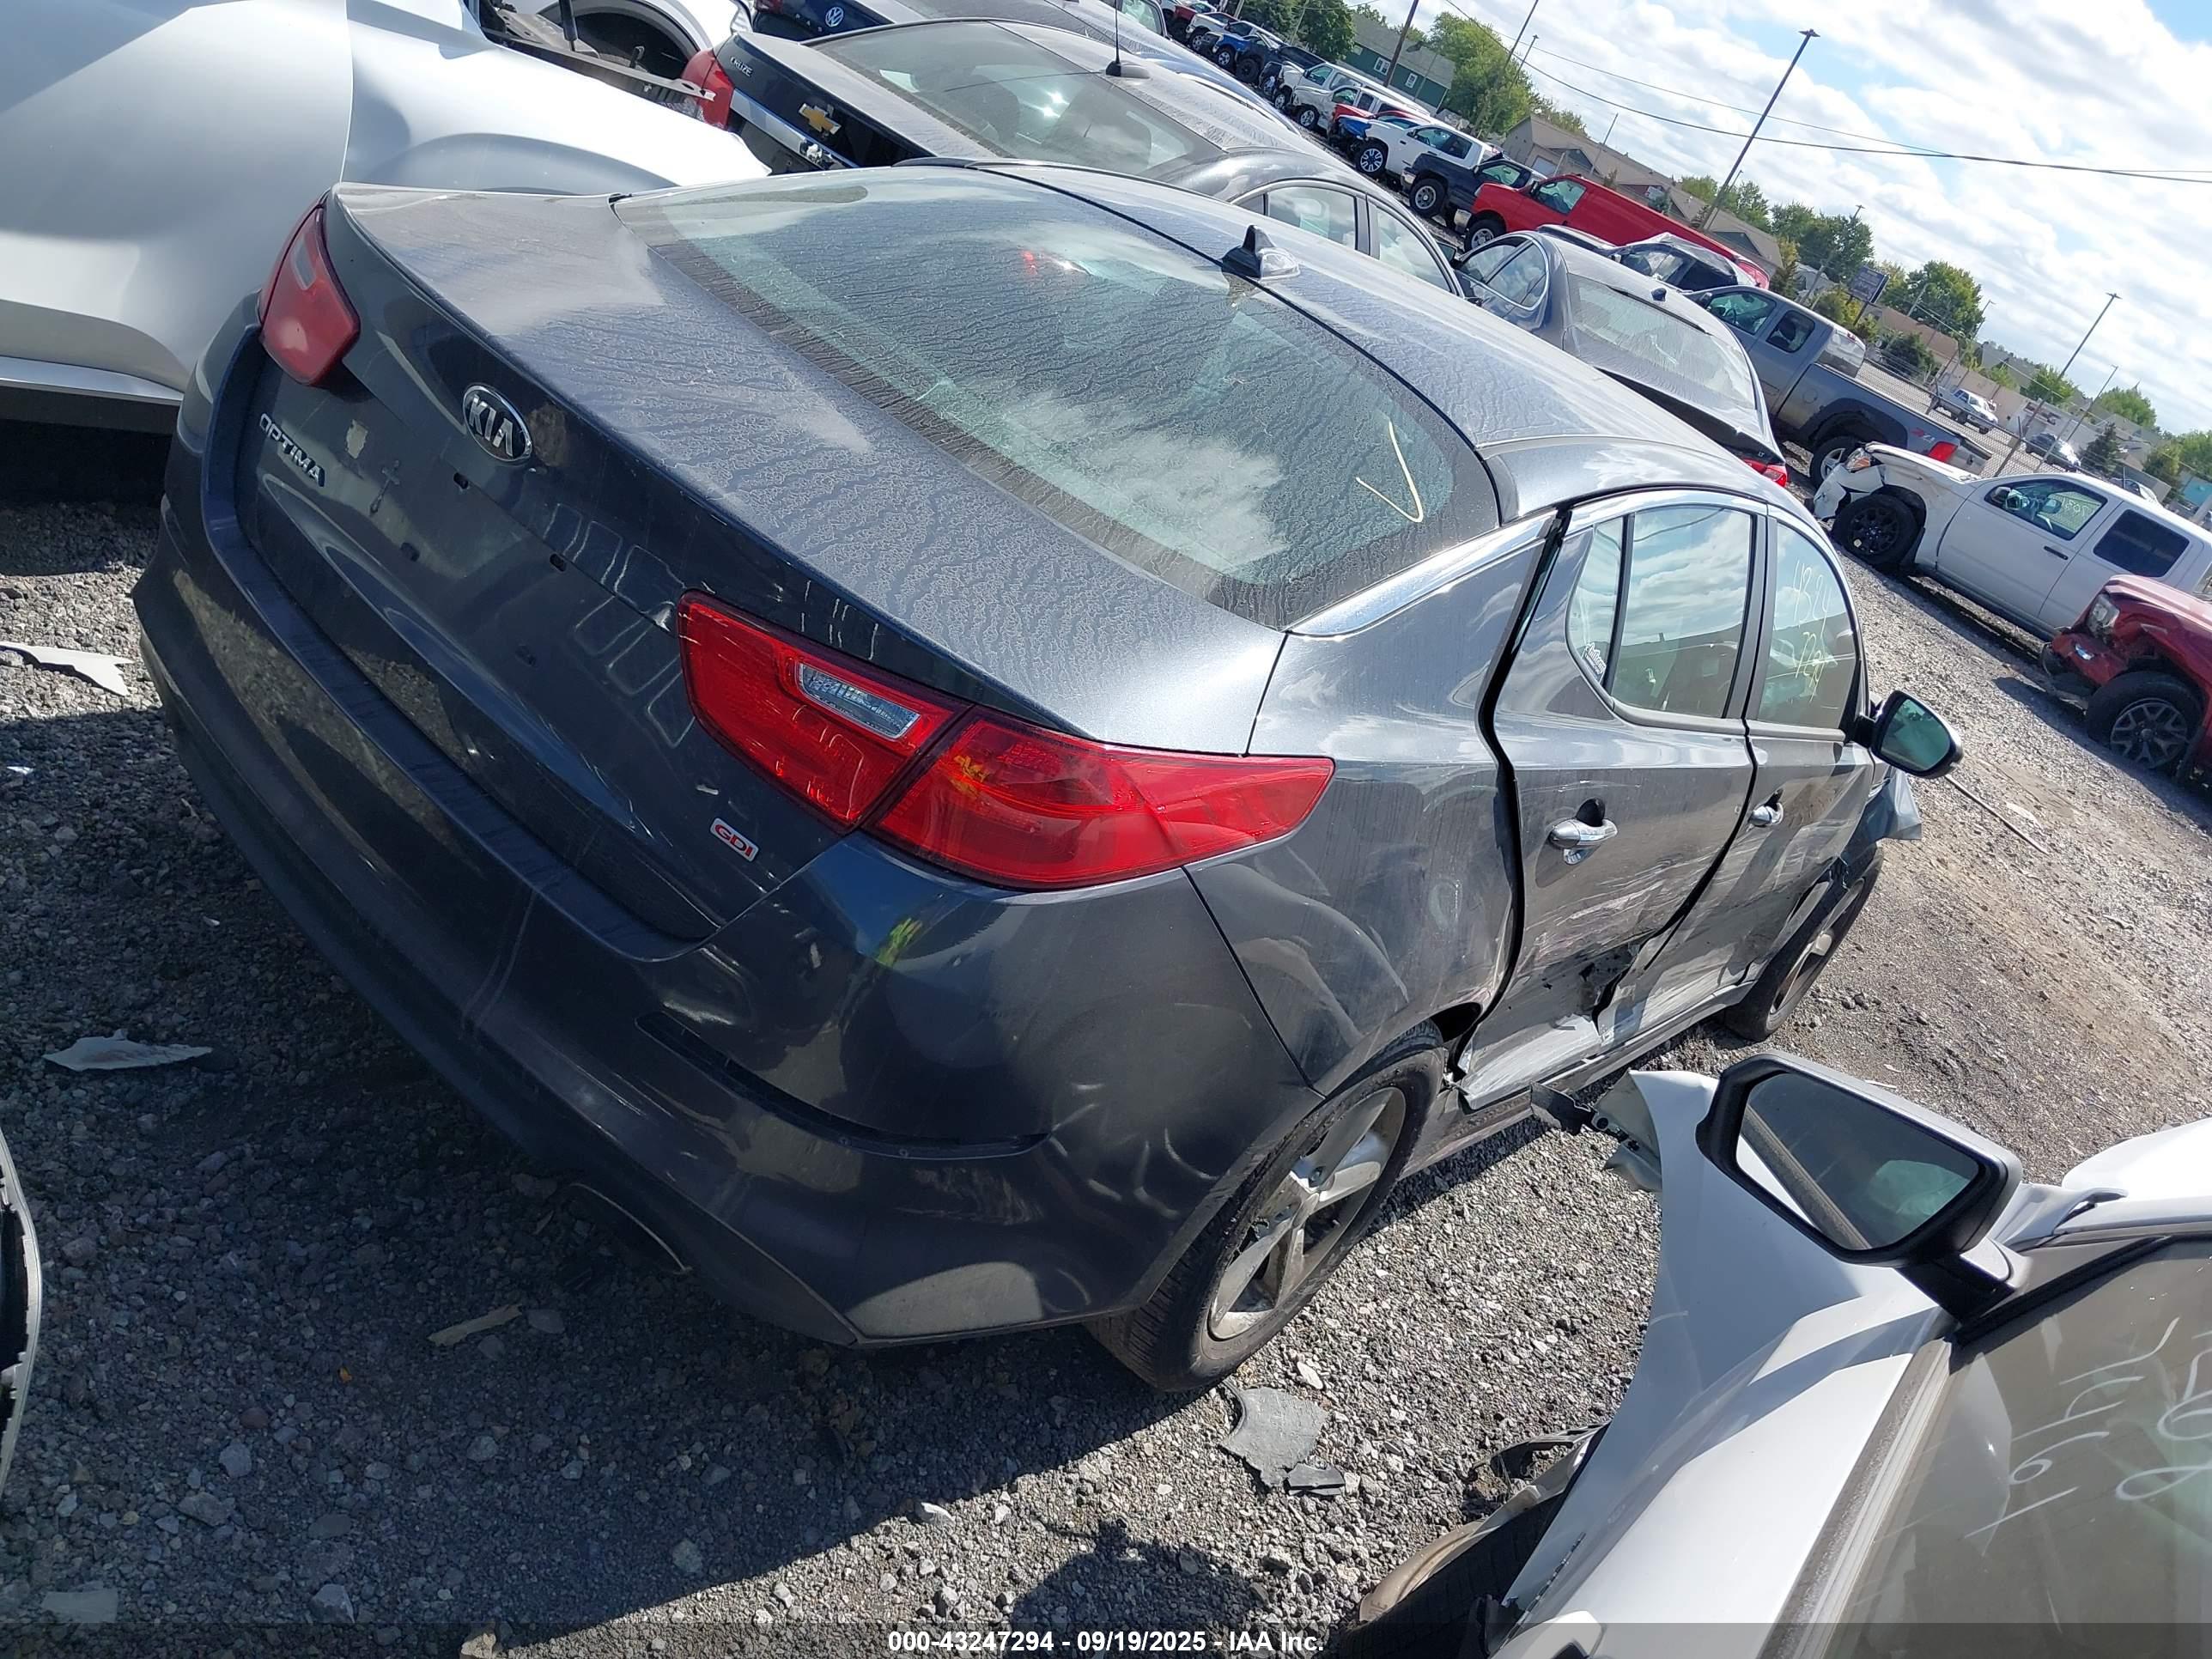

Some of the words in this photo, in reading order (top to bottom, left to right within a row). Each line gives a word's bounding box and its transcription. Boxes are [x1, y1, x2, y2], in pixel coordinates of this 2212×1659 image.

[825, 7, 844, 27] VW
[259, 412, 325, 487] OPTIMA
[468, 393, 514, 458] KIA
[714, 824, 753, 857] GDI
